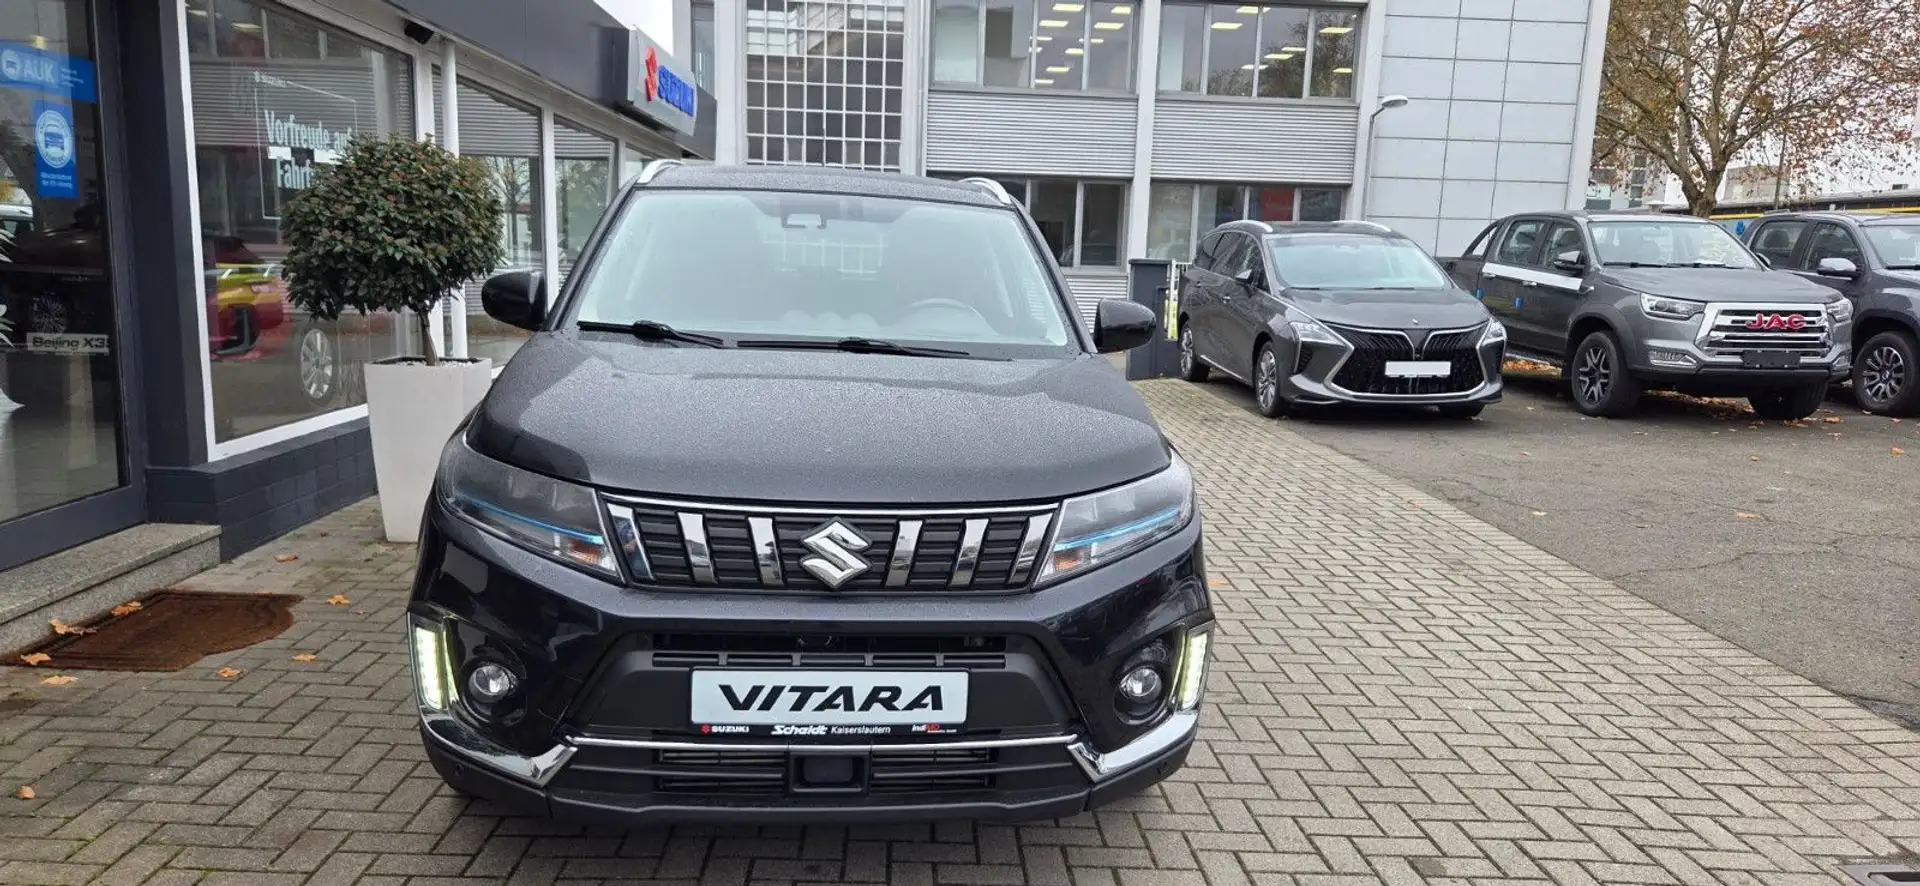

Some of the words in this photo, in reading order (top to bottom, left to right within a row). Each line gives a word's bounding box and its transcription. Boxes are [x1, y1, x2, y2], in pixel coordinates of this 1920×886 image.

[23, 58, 56, 85] AUK
[658, 65, 694, 117] SUZUKI
[264, 109, 330, 151] Vorfreude
[1745, 313, 1807, 329] JAC
[33, 336, 79, 351] Beijing
[718, 684, 943, 712] VITARA
[711, 725, 750, 733] SUZUKI
[831, 725, 891, 735] Kaiserslautern
